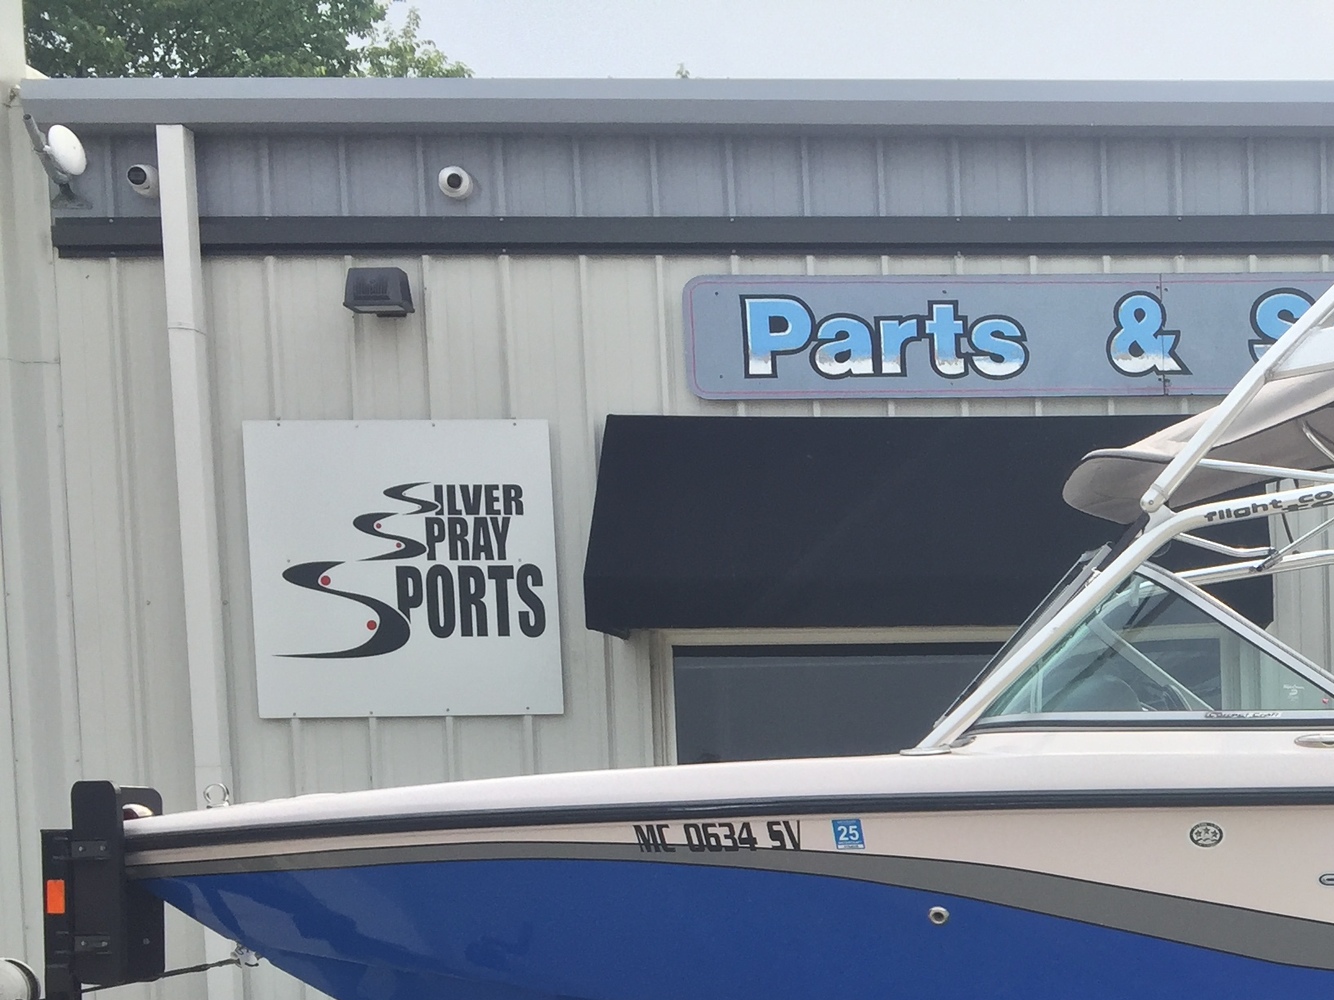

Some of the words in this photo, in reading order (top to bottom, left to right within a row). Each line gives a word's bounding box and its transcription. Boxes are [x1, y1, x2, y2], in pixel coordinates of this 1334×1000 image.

[739, 294, 1029, 380] Parts
[1106, 290, 1193, 376] &
[383, 481, 524, 516] SILVER
[1204, 498, 1283, 522] flight
[353, 512, 511, 561] SPRAY
[272, 561, 546, 659] SPORTS
[633, 823, 676, 853] MC
[683, 821, 757, 852] 0634
[766, 819, 800, 851] SV
[837, 825, 860, 841] 25
